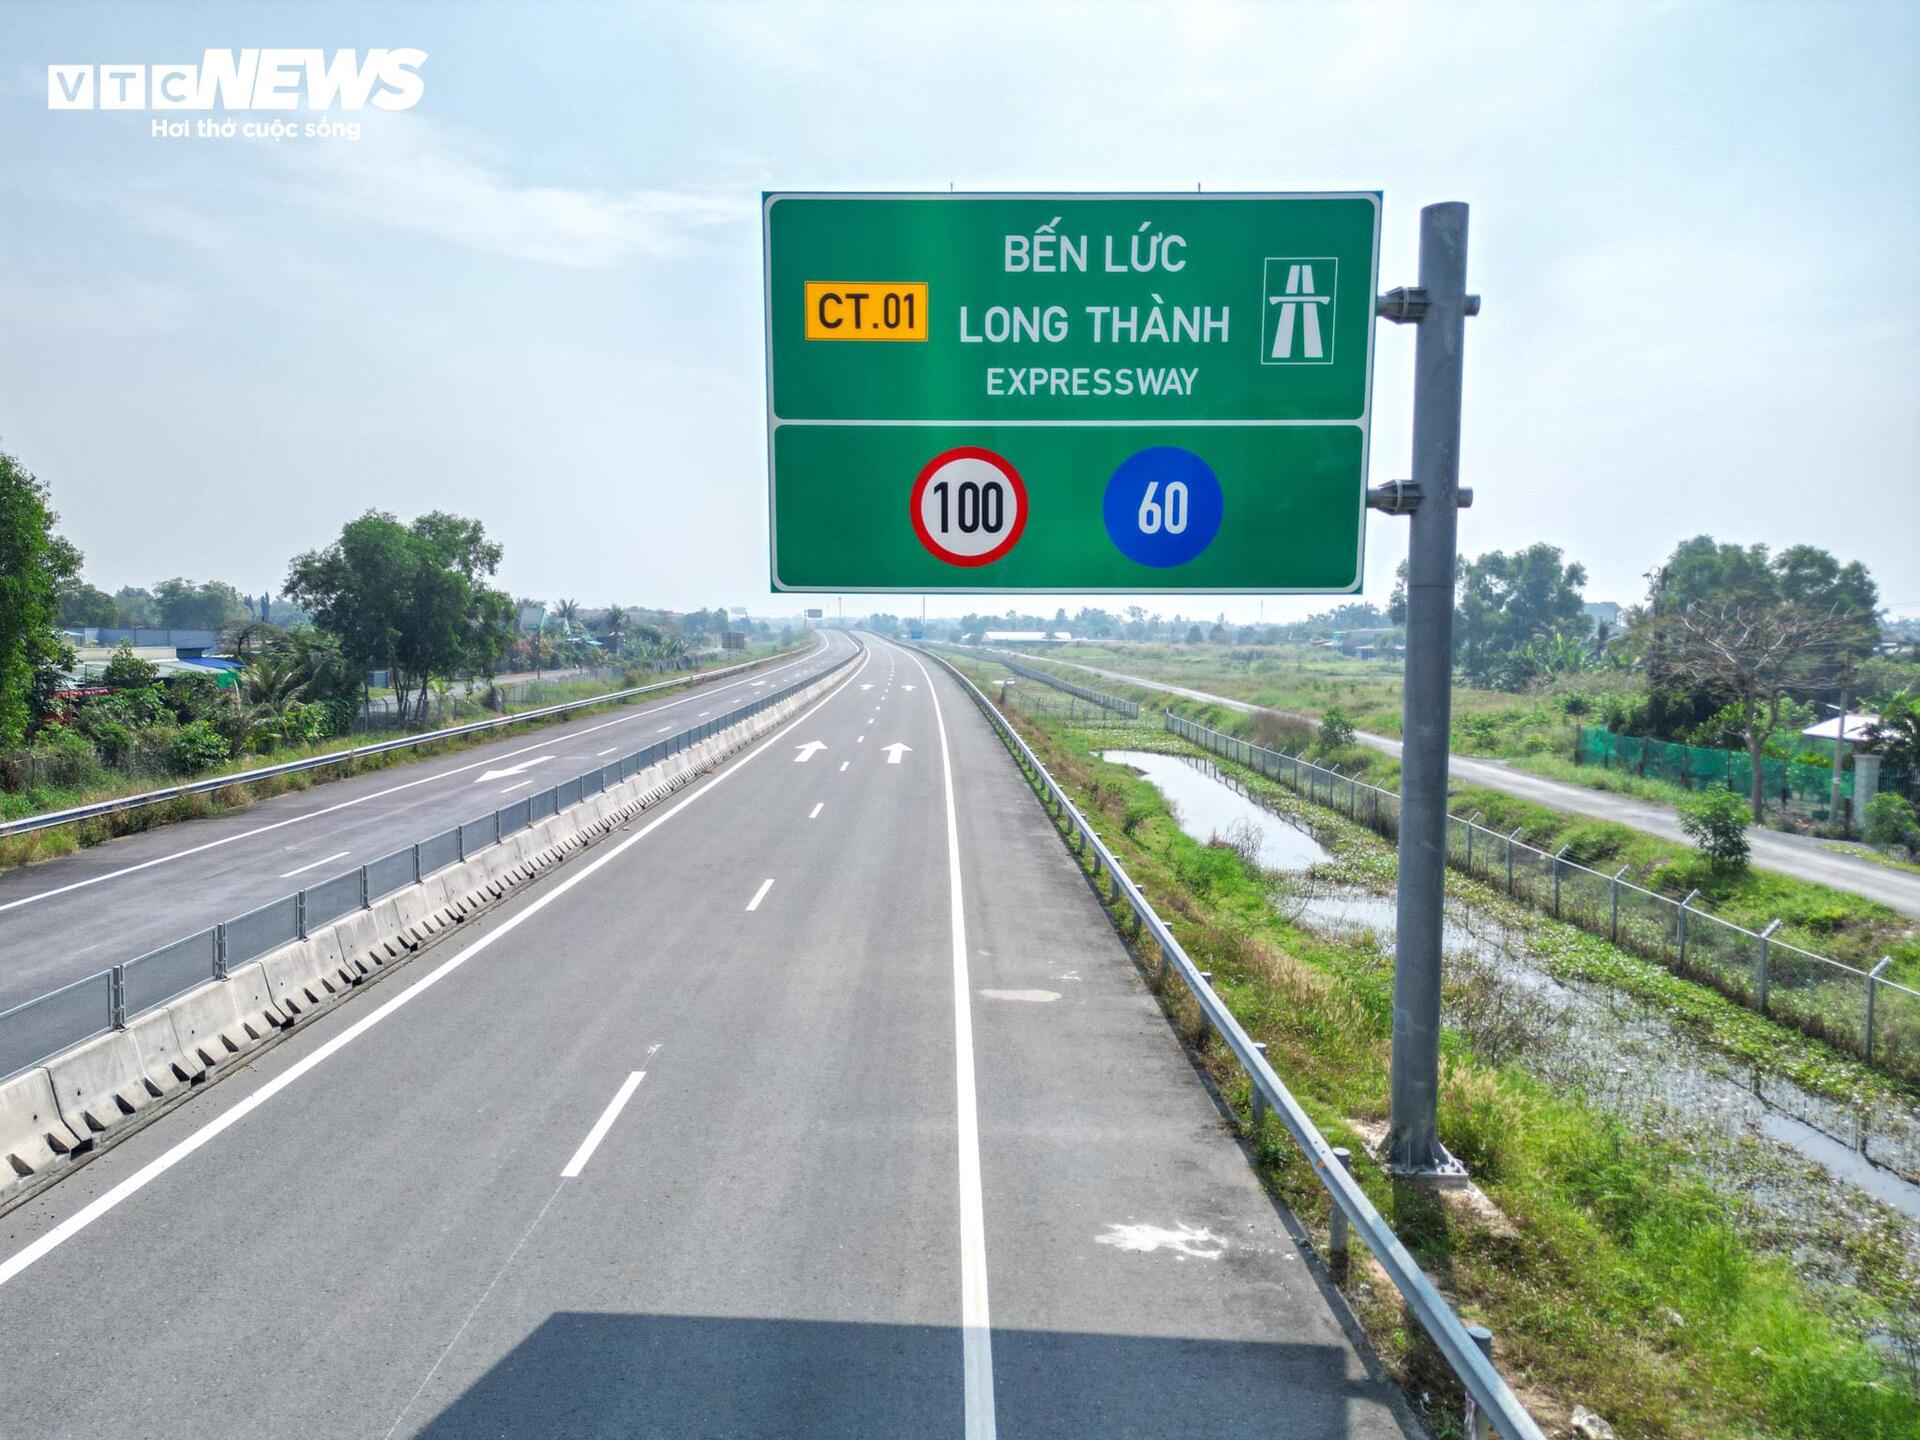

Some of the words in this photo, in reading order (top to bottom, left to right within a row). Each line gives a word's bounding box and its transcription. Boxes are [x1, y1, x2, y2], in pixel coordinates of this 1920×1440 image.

[1005, 216, 1088, 273] BẾN
[1105, 221, 1187, 273] LỨC
[818, 292, 914, 330] CT.01
[960, 305, 1068, 343] LONG
[1086, 293, 1230, 343] THÀNH
[987, 367, 1199, 396] EXPRESSWAY
[933, 481, 1004, 534] 100
[1138, 481, 1188, 534] 60
